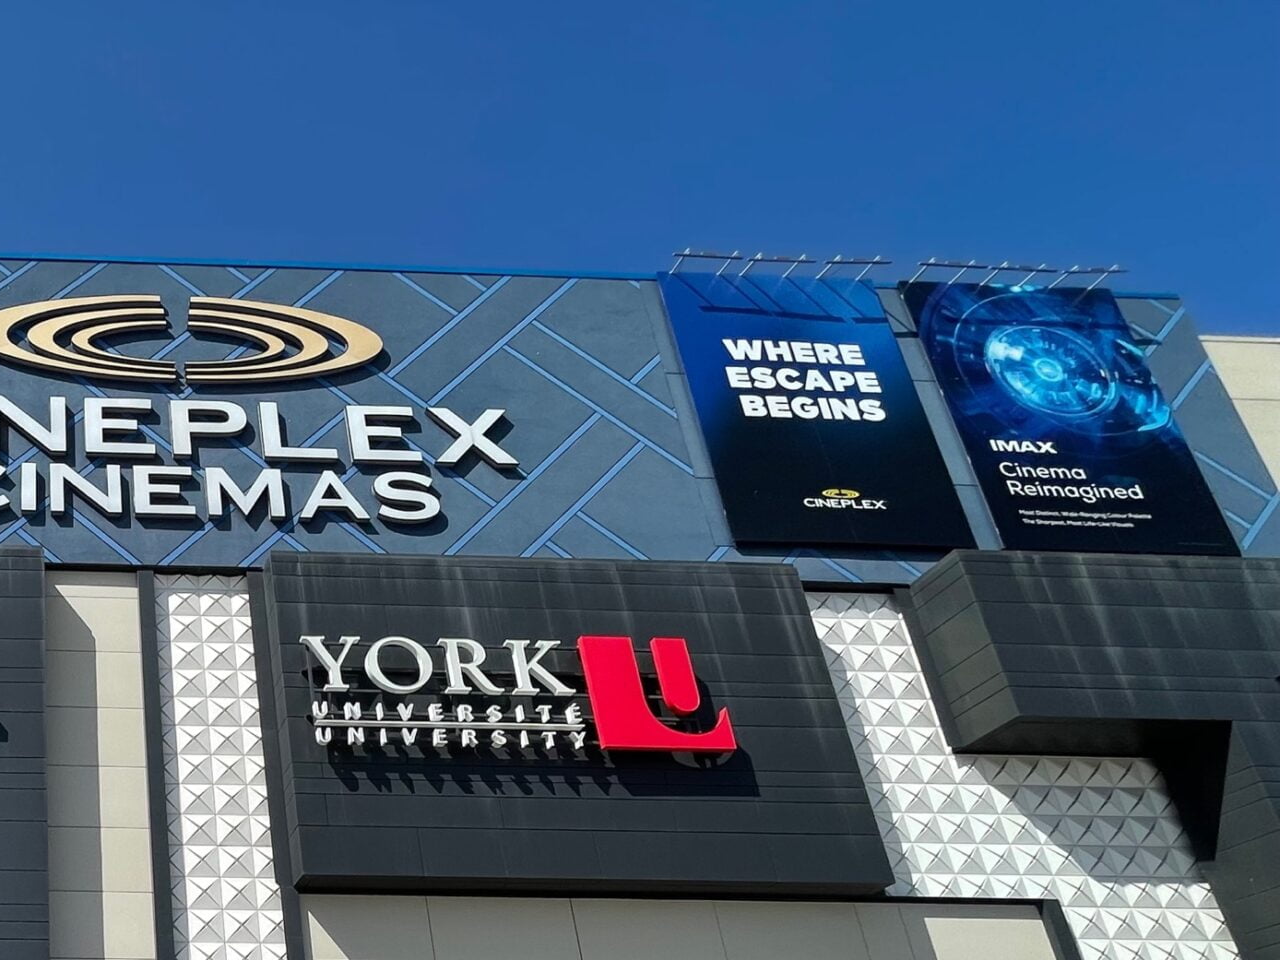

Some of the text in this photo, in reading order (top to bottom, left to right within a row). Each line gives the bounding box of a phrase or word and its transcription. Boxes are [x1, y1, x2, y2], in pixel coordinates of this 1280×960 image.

[722, 338, 866, 366] WHERE
[725, 366, 883, 394] ESCAPE
[738, 394, 887, 422] BEGINS
[988, 439, 1058, 455] IMAX
[998, 462, 1087, 480] Cinema
[803, 497, 888, 510] CINEPLEX
[1005, 480, 1145, 503] Reimagined
[299, 635, 577, 696] YORK
[311, 700, 583, 725] UNIVERSITÉ
[314, 726, 586, 750] UNIVERSITY
